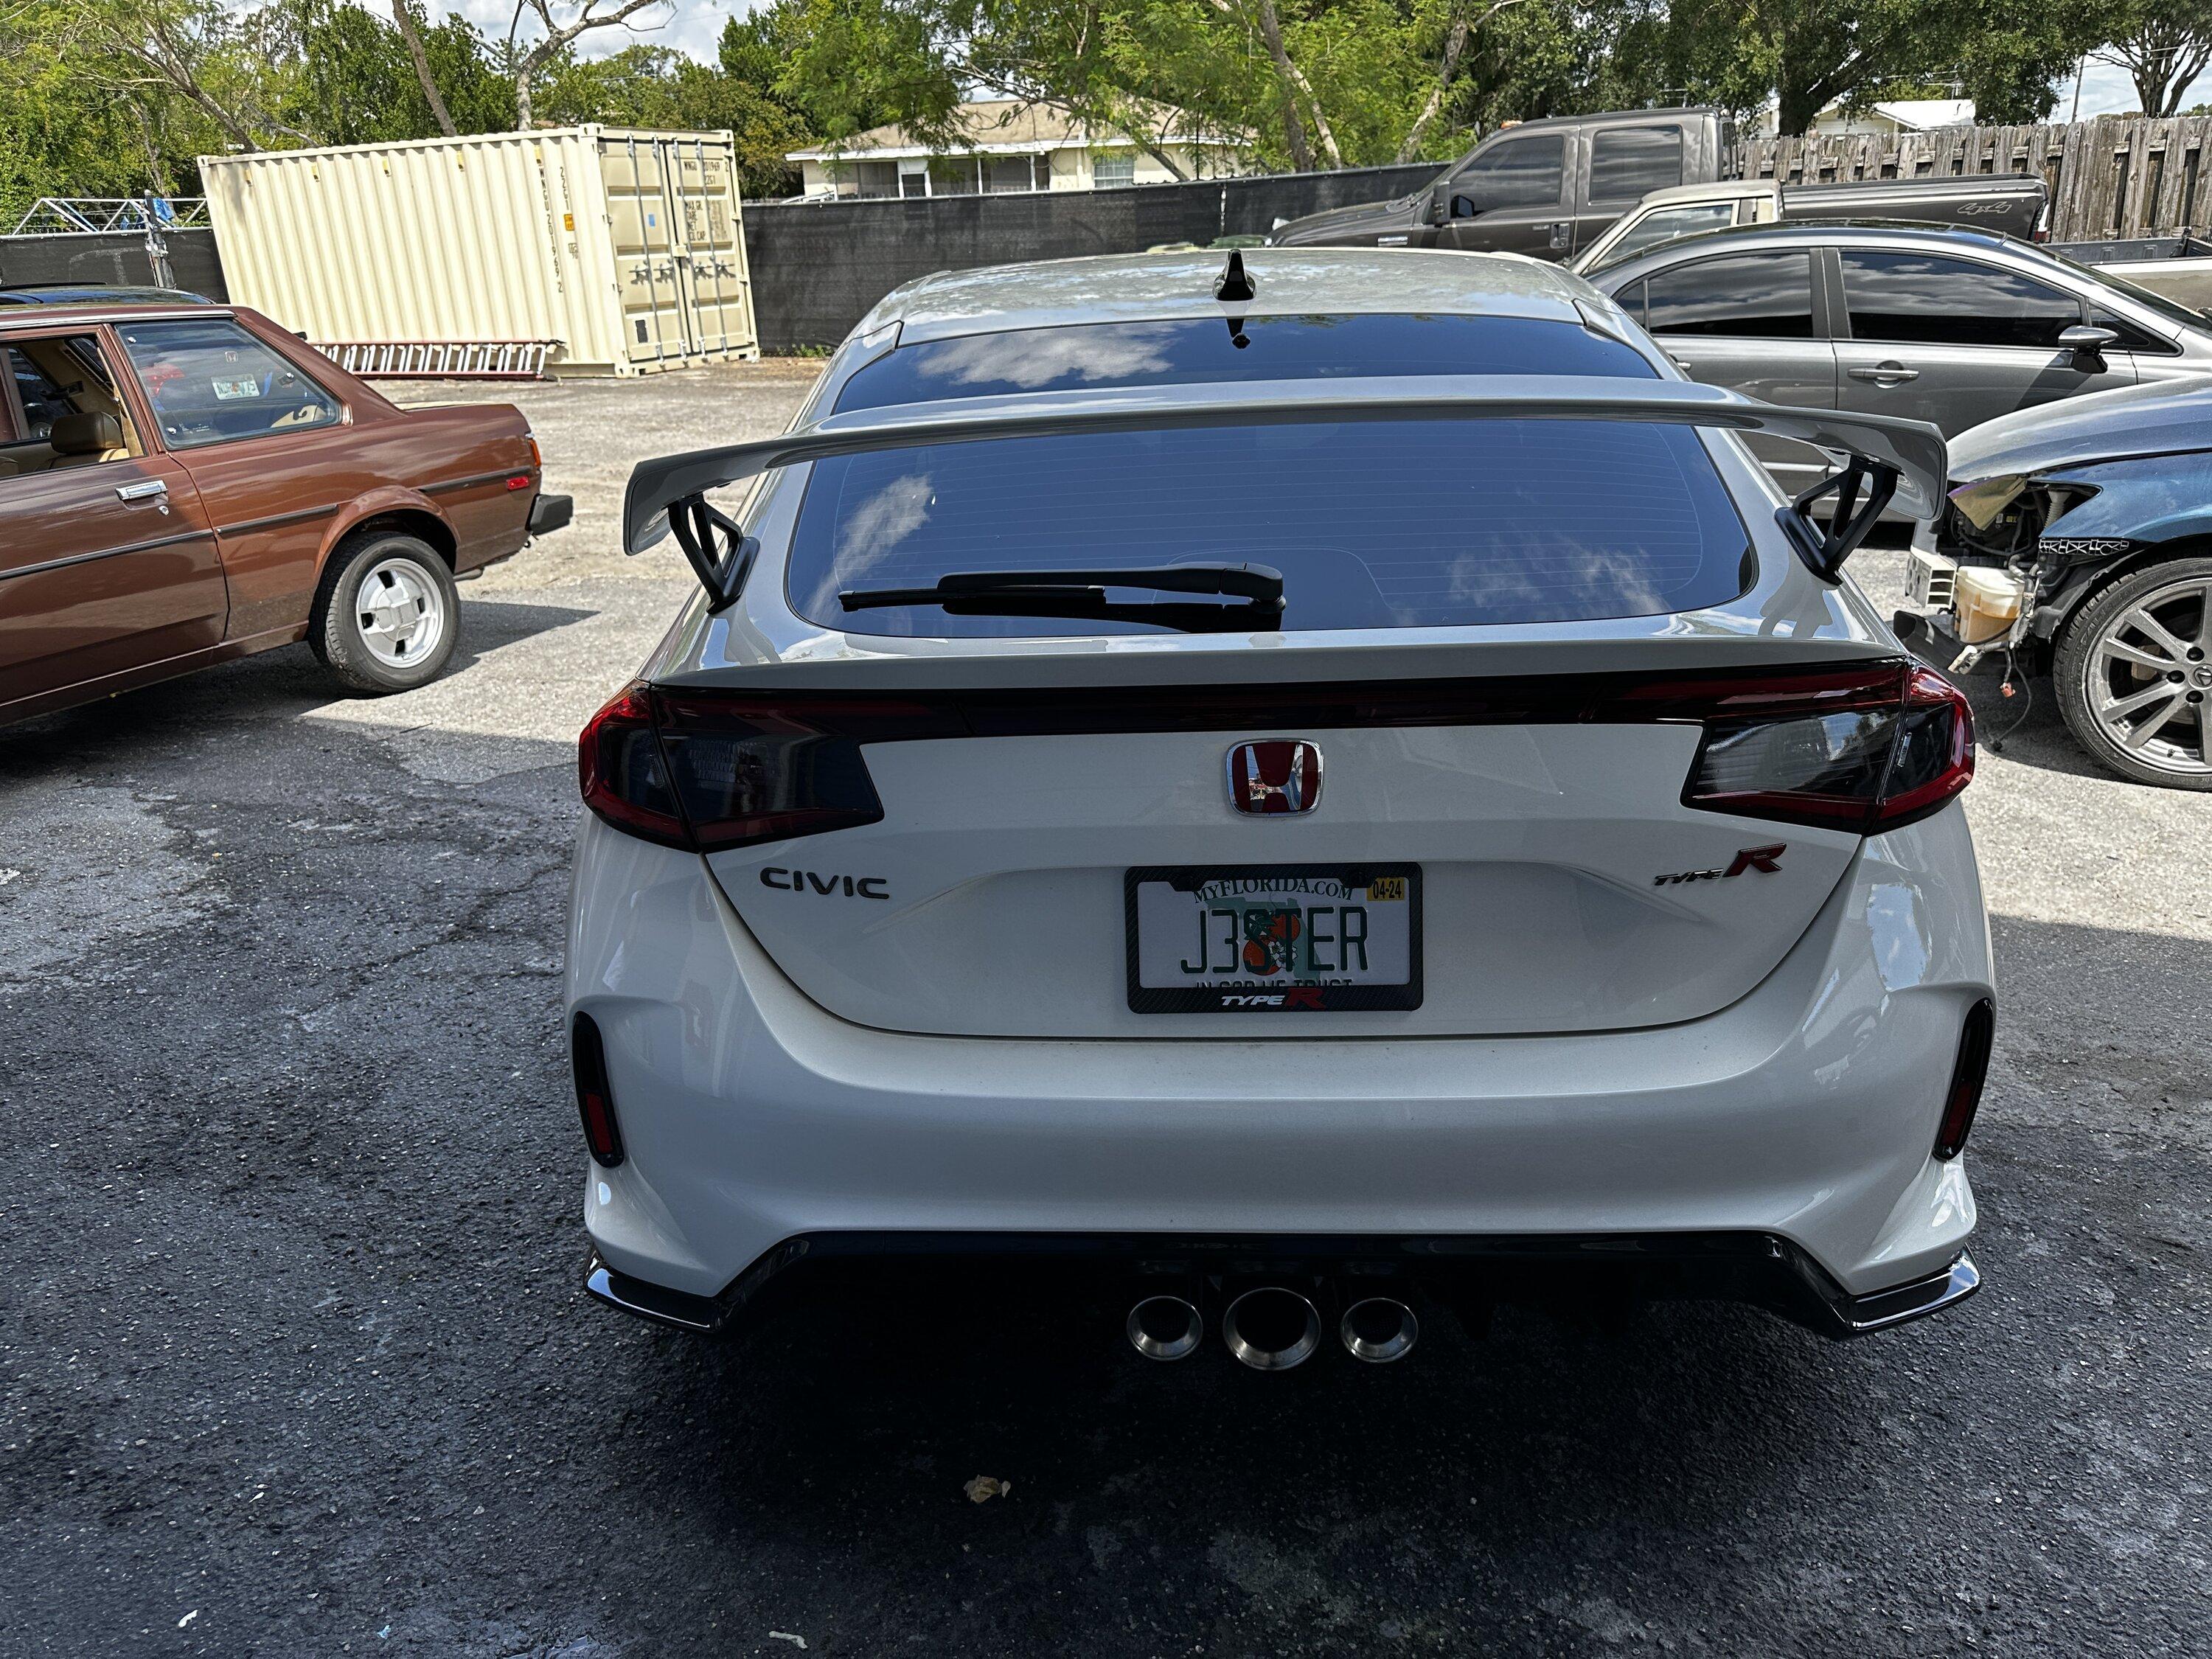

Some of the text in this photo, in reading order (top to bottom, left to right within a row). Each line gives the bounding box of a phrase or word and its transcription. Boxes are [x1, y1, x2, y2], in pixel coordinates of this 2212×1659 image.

[546, 214, 560, 277] 201969
[1655, 843, 1787, 886] TYPE R
[759, 867, 889, 900] CIVIC
[1193, 877, 1355, 904] MYFLORIDA.COM
[1372, 880, 1402, 900] 04-24
[1180, 906, 1369, 974] J3STER
[1220, 987, 1326, 1009] TYPE R
